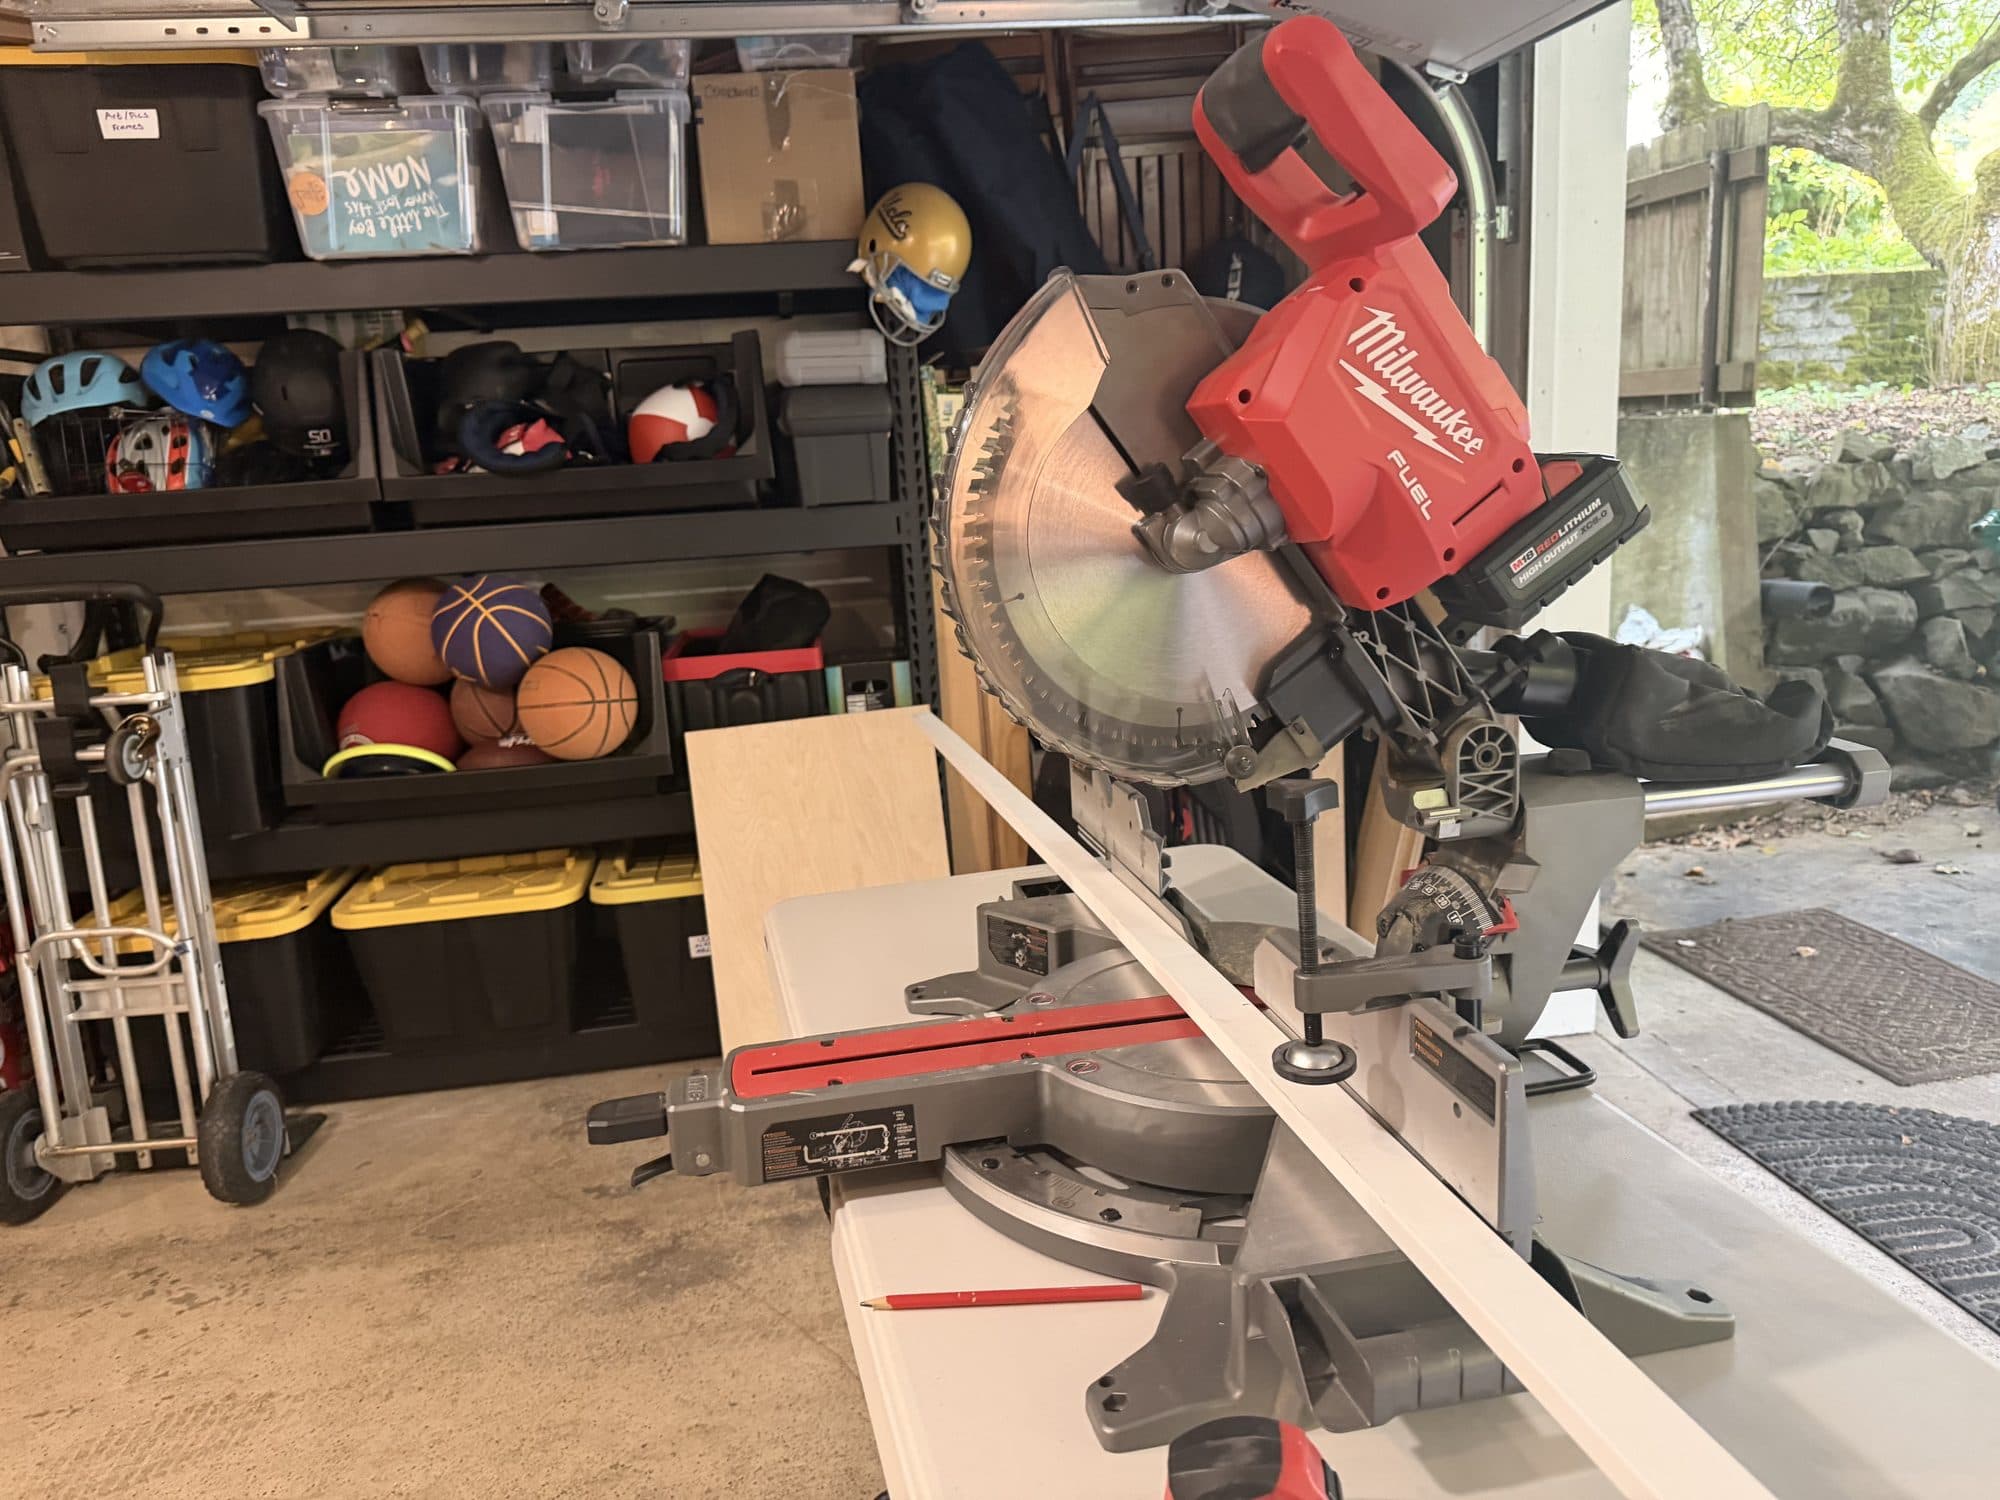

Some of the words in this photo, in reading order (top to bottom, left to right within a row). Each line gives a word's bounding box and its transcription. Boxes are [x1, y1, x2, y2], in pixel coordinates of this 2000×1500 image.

[348, 218, 376, 238] Boy
[423, 202, 449, 218] The
[1347, 306, 1484, 456] Milwaukee
[307, 429, 332, 444] 50
[1387, 449, 1433, 521] FUEL
[1511, 548, 1536, 572] M18
[1536, 497, 1602, 556] REDLITHIUM
[1519, 561, 1543, 584] HIGH
[1543, 531, 1579, 564] OUTPUT
